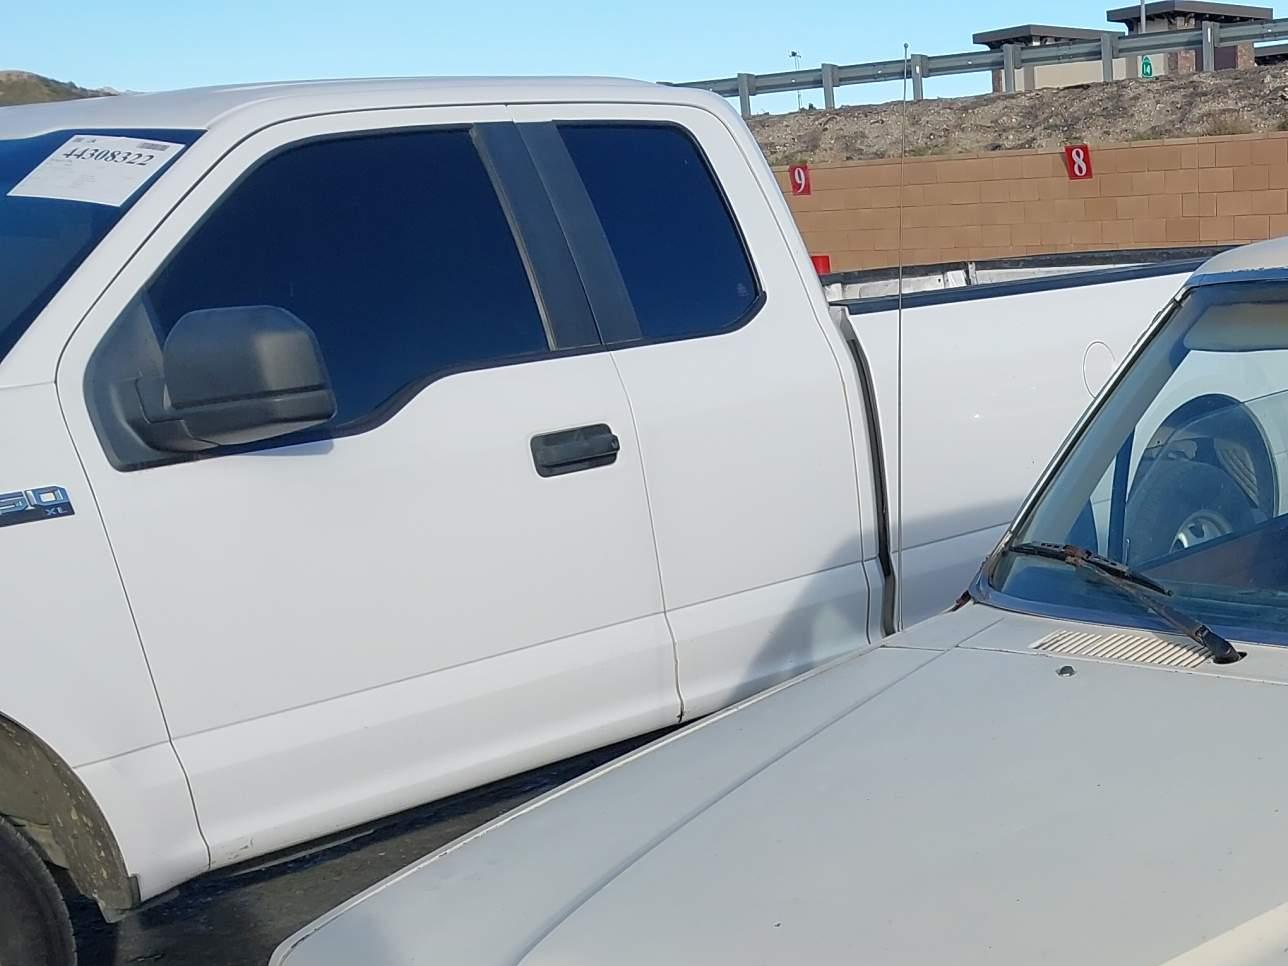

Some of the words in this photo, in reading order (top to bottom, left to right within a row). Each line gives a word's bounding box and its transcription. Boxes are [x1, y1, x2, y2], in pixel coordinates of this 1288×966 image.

[64, 147, 155, 166] 44308322
[1071, 148, 1087, 177] 8
[794, 167, 806, 193] 9
[45, 506, 68, 516] XL
